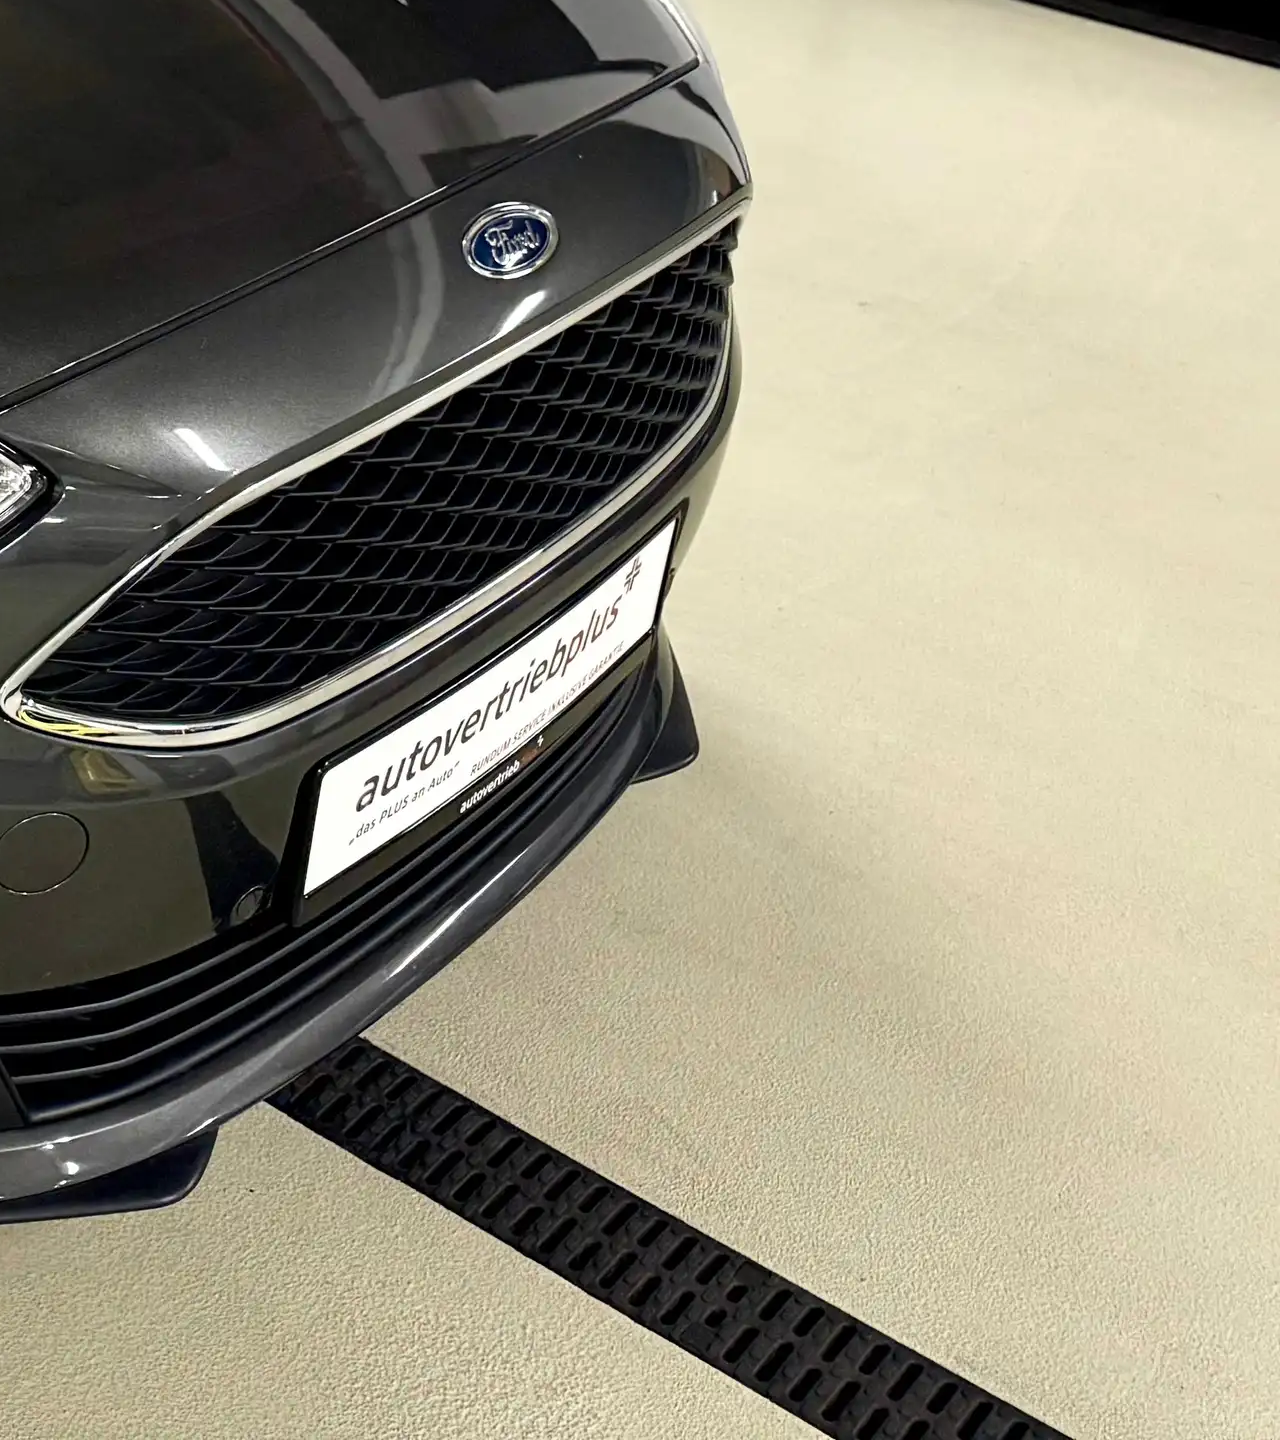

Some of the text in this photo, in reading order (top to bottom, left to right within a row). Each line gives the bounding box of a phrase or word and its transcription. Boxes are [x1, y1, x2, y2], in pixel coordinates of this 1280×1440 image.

[484, 219, 541, 269] Ford
[356, 593, 623, 813] autovertriebplus
[470, 737, 512, 777] RUNDUM
[511, 708, 547, 745] SERVICE
[379, 794, 410, 824] PLUS
[411, 786, 425, 803] an
